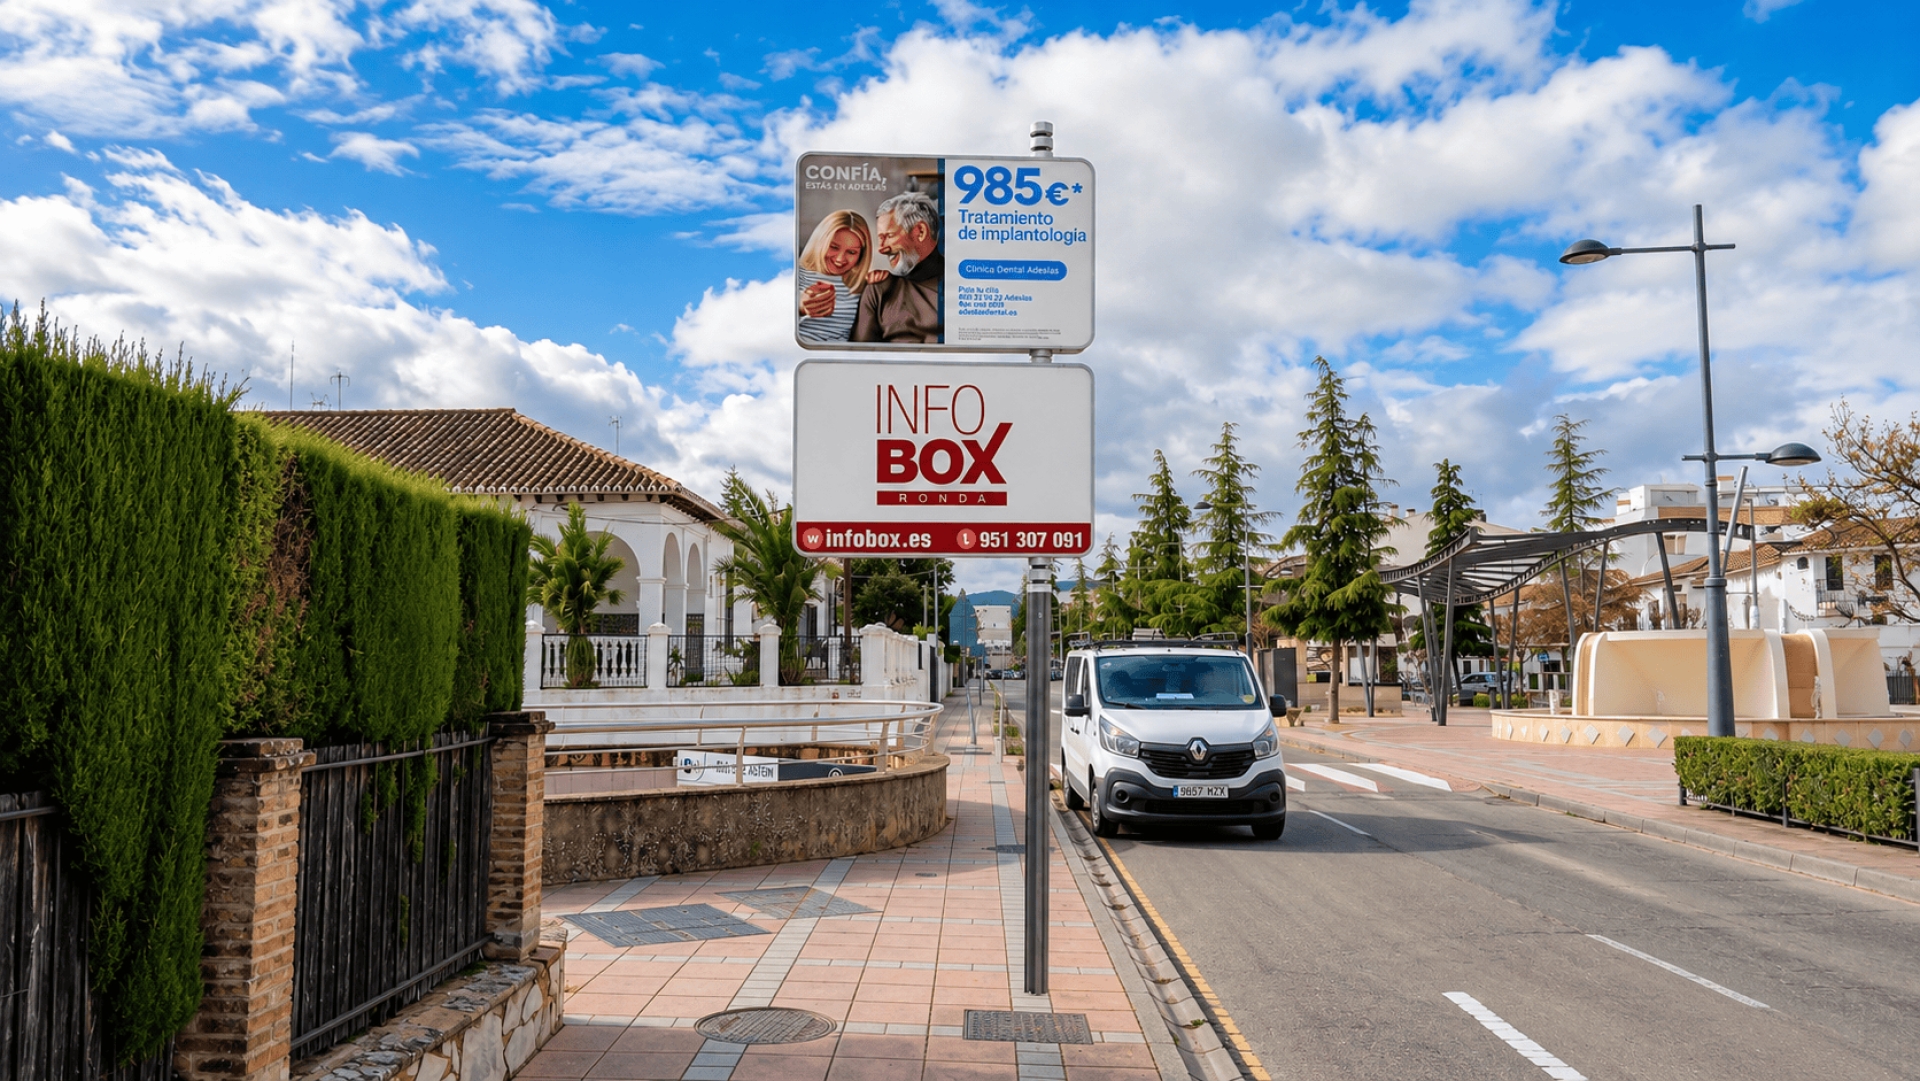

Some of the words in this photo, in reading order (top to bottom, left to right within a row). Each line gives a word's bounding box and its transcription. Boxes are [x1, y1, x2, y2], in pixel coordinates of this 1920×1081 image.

[805, 162, 887, 185] CONFÍA,
[958, 209, 1054, 226] Tratamiento
[958, 226, 977, 240] de
[996, 265, 1025, 275] Dental
[876, 384, 985, 435] INFO
[876, 422, 1013, 485] BOX
[899, 493, 986, 504] RONDA
[825, 528, 932, 549] infobox.es
[980, 531, 1010, 548] 951
[1016, 531, 1047, 548] 307
[1052, 531, 1083, 549] 091
